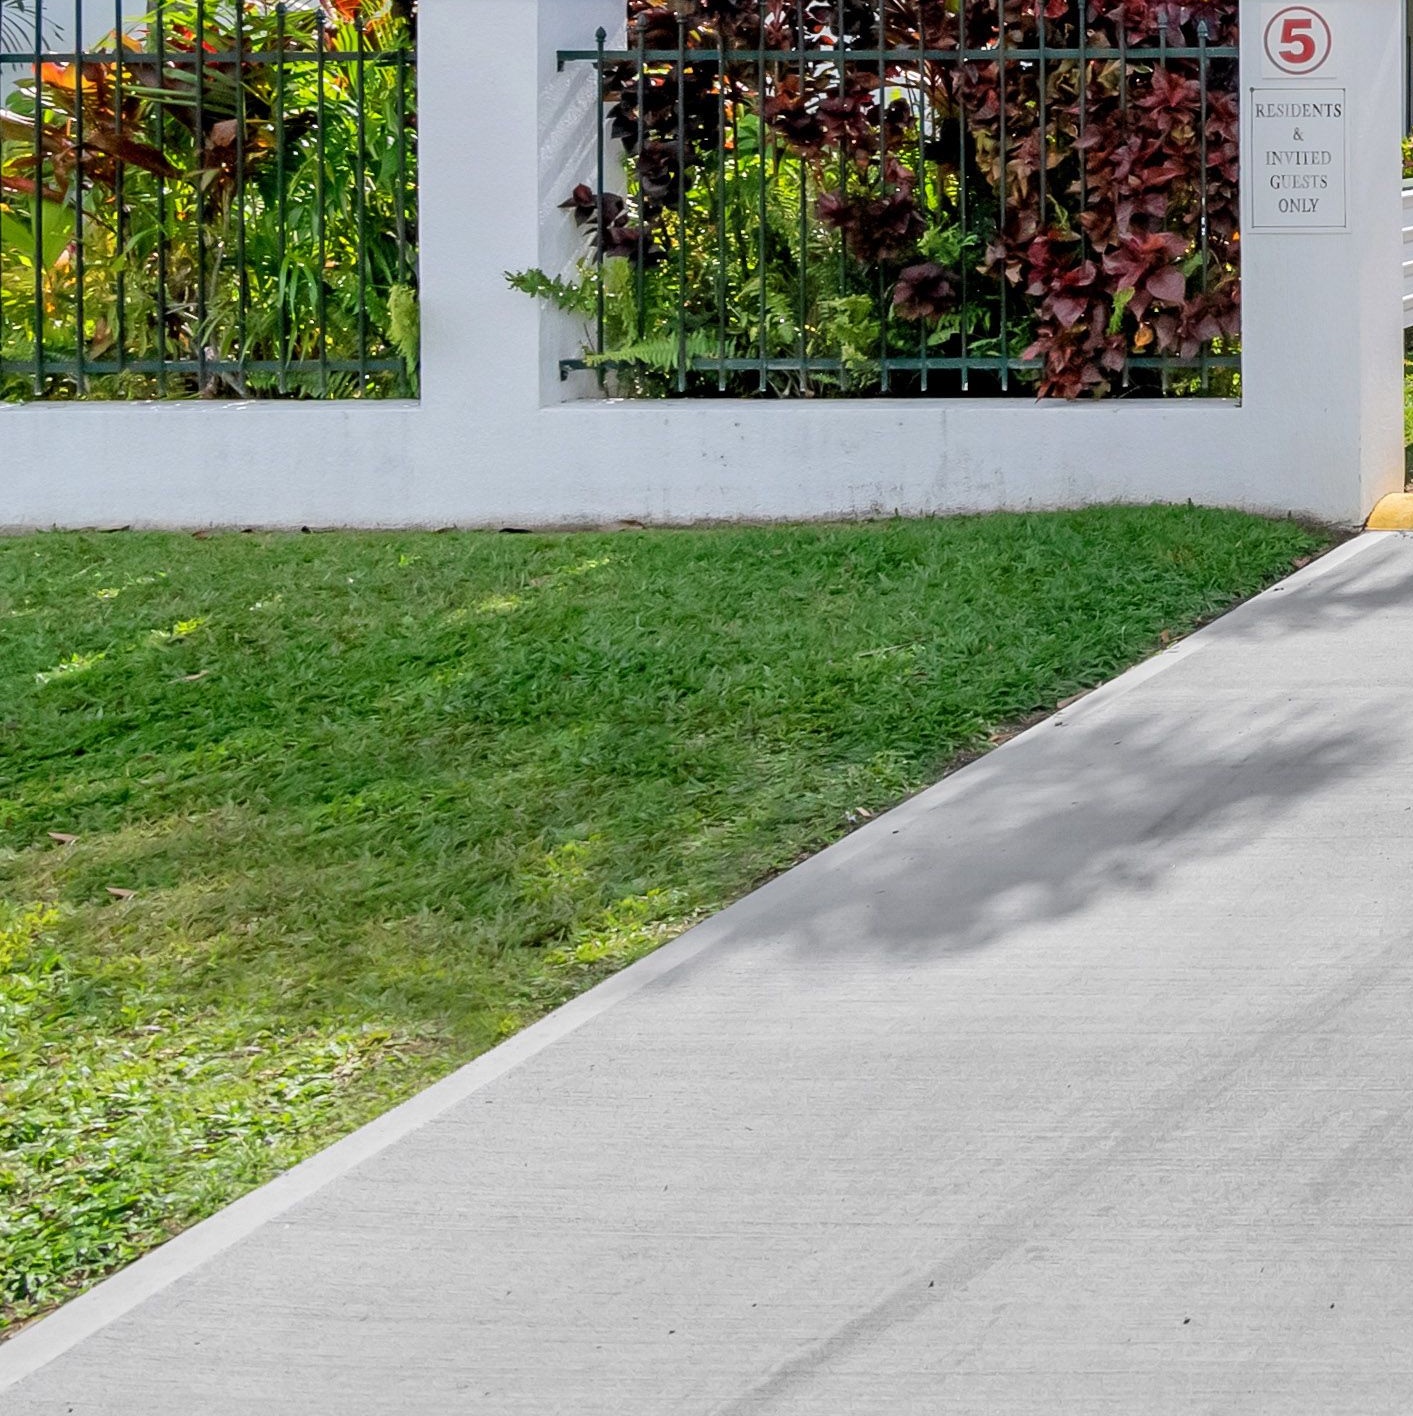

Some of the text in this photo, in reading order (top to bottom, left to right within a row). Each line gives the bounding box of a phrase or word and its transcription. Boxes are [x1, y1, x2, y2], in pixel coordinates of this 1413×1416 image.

[1278, 18, 1316, 64] 5
[1255, 103, 1342, 119] RESIDENTS
[1292, 126, 1304, 142] &
[1265, 150, 1332, 166] INVITED
[1269, 174, 1328, 190] GUESTS
[1278, 197, 1320, 214] ONLY
